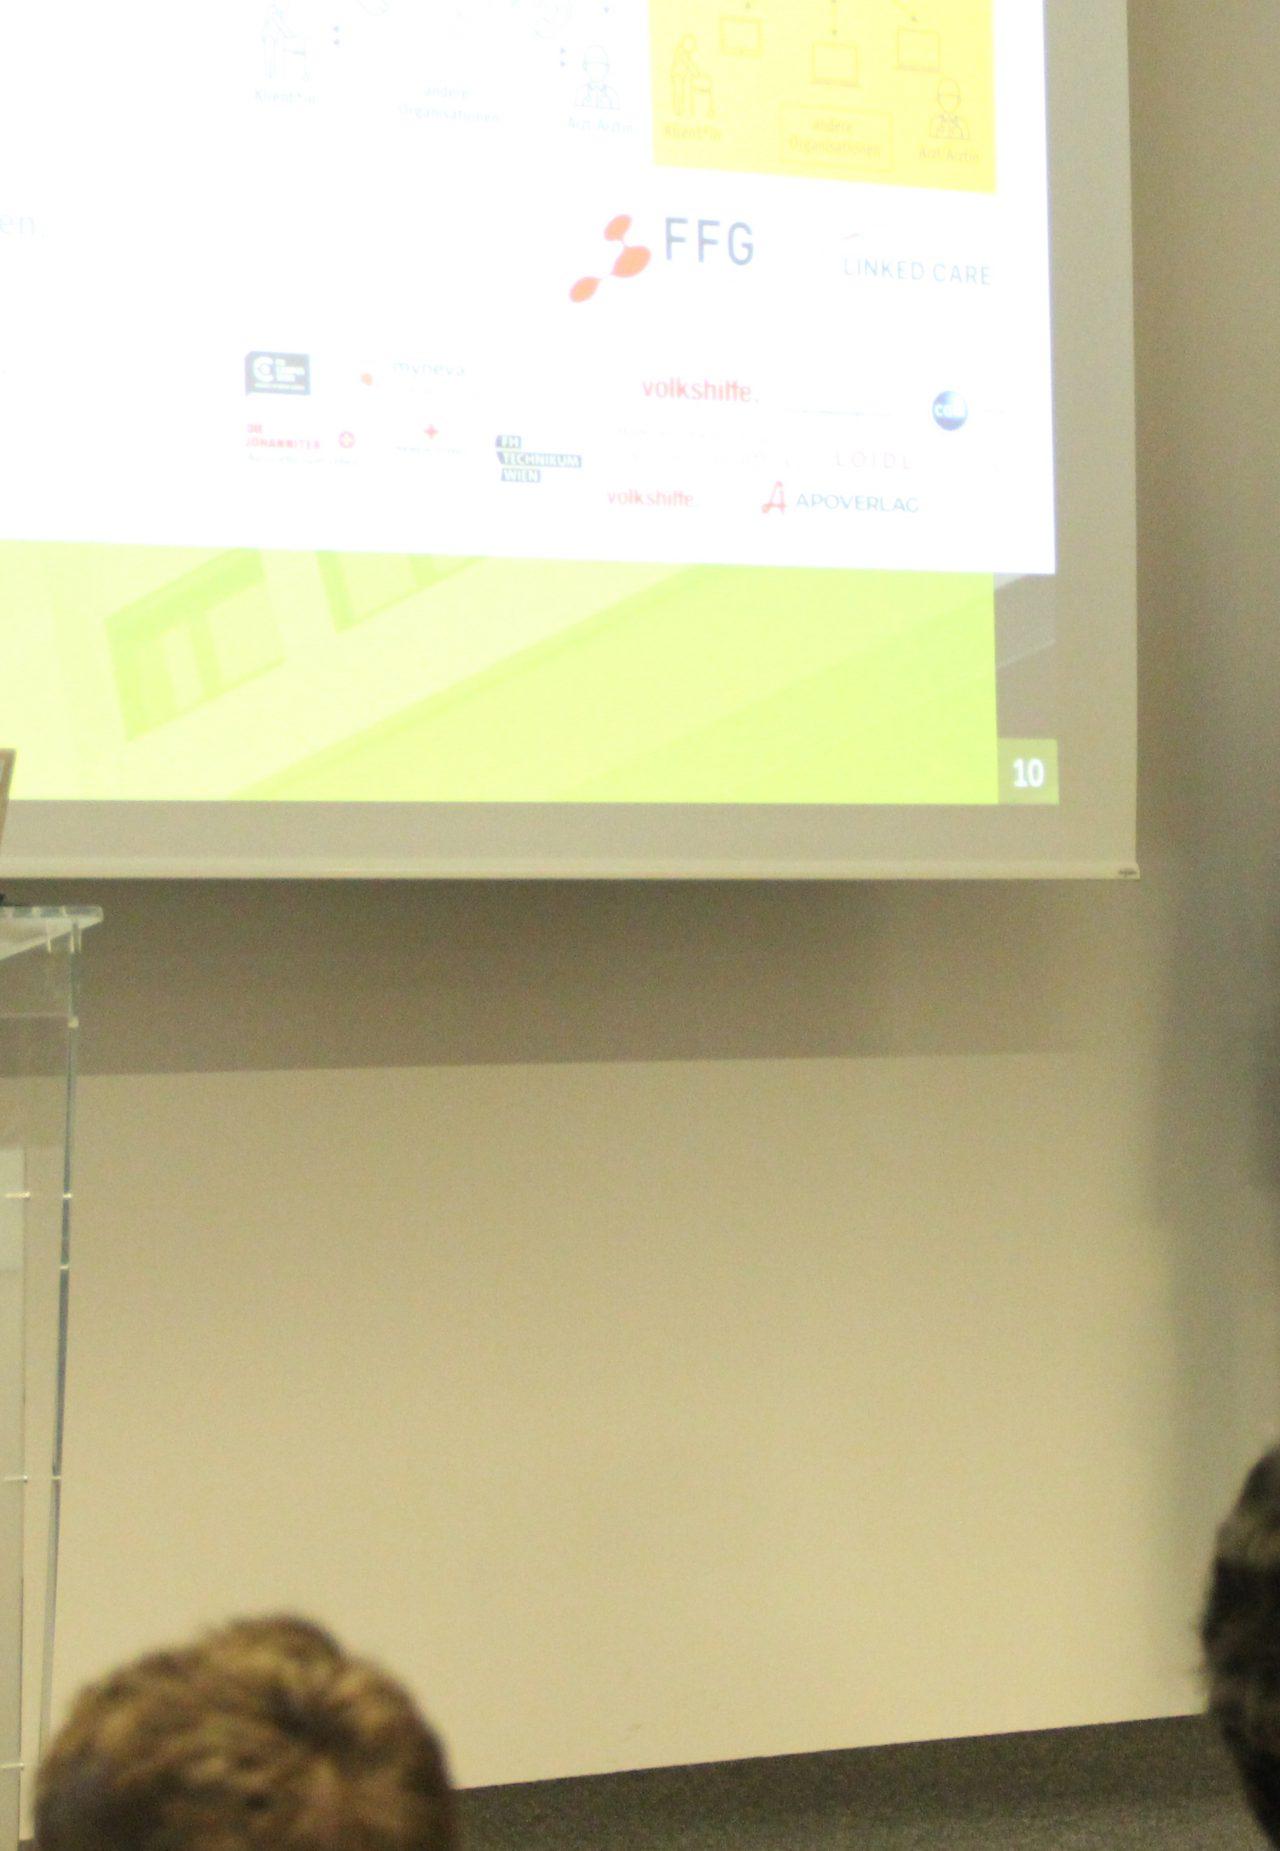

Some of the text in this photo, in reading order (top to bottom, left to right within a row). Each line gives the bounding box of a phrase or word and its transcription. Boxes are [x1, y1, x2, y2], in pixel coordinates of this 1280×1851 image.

[665, 217, 754, 266] FFG
[843, 257, 991, 287] LINKED CARE
[503, 452, 579, 468] TECHNIKUM
[503, 468, 538, 482] WIEN
[1013, 757, 1044, 788] 10
